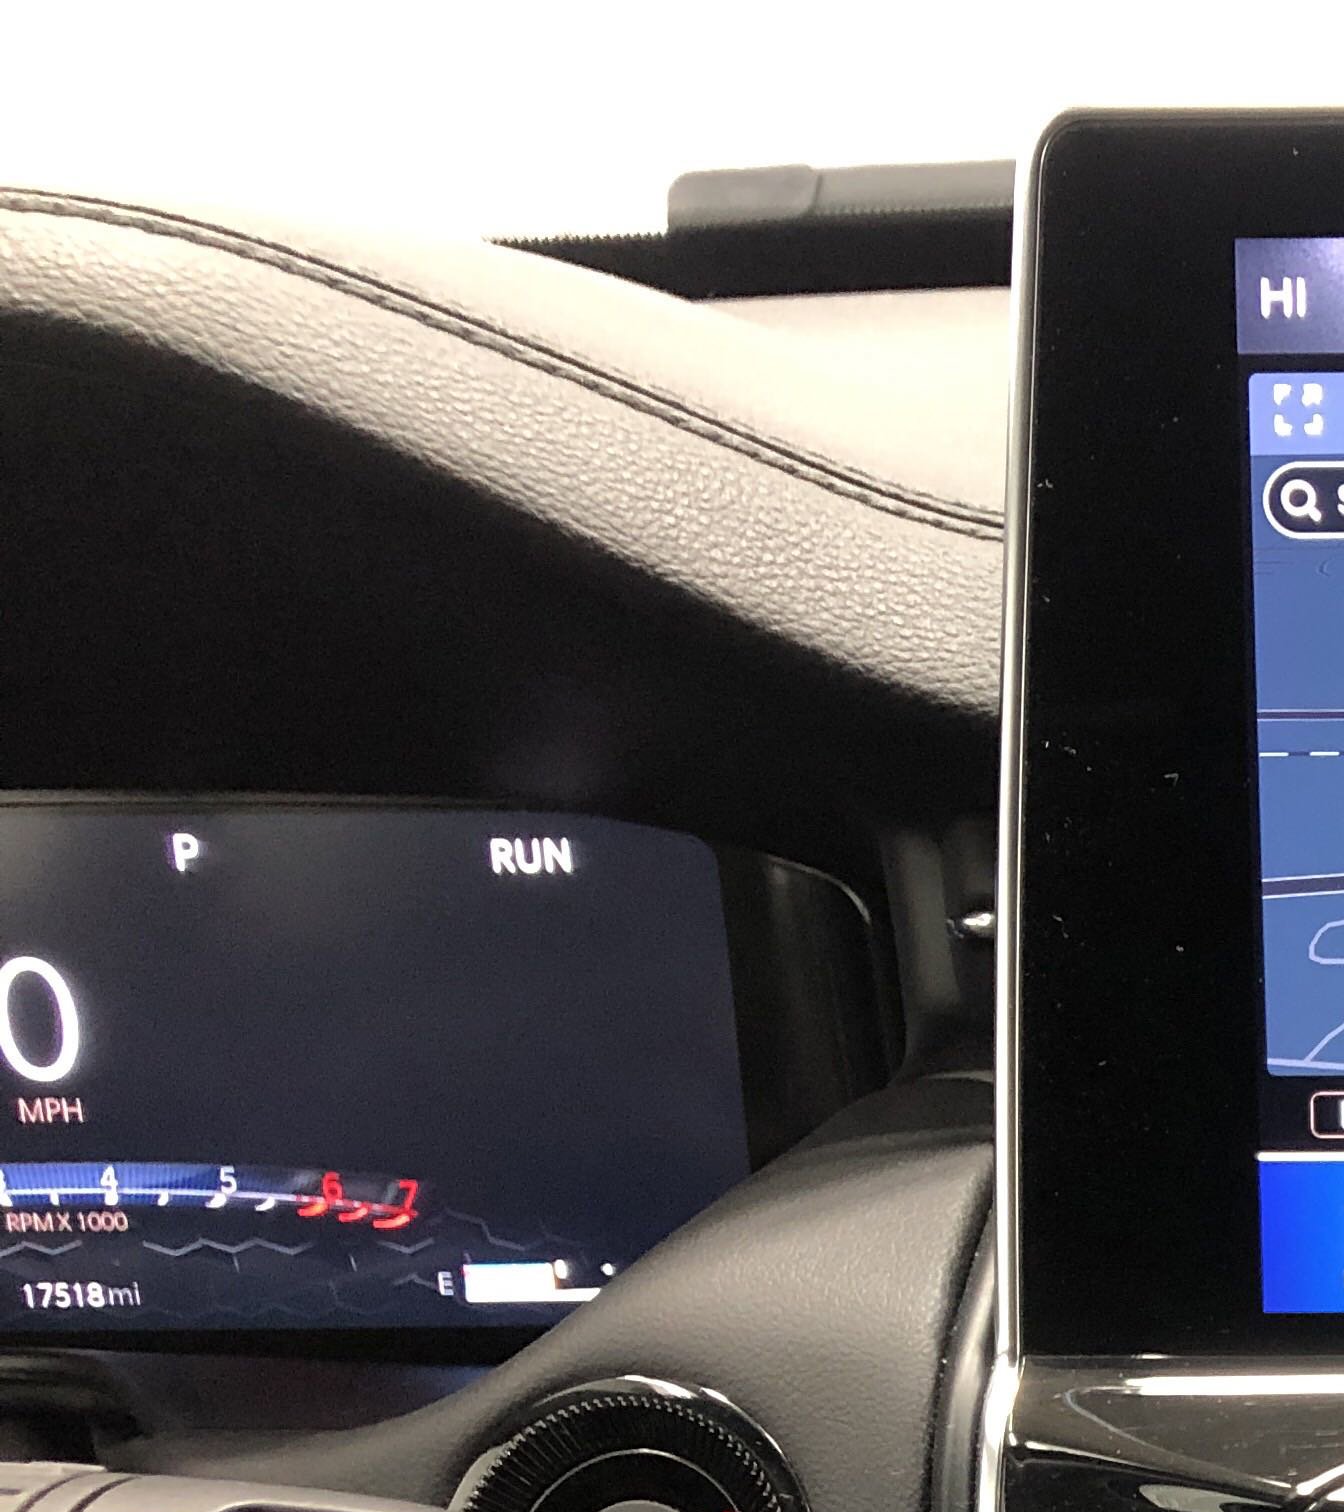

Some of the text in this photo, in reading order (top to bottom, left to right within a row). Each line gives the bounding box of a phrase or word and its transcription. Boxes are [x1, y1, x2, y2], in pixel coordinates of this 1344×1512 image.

[1260, 277, 1308, 318] HI
[173, 834, 199, 871] P
[490, 838, 572, 873] RUN
[18, 1098, 84, 1123] MPH
[6, 1213, 53, 1232] RPM
[76, 1211, 128, 1231] 1000
[439, 1273, 454, 1296] E
